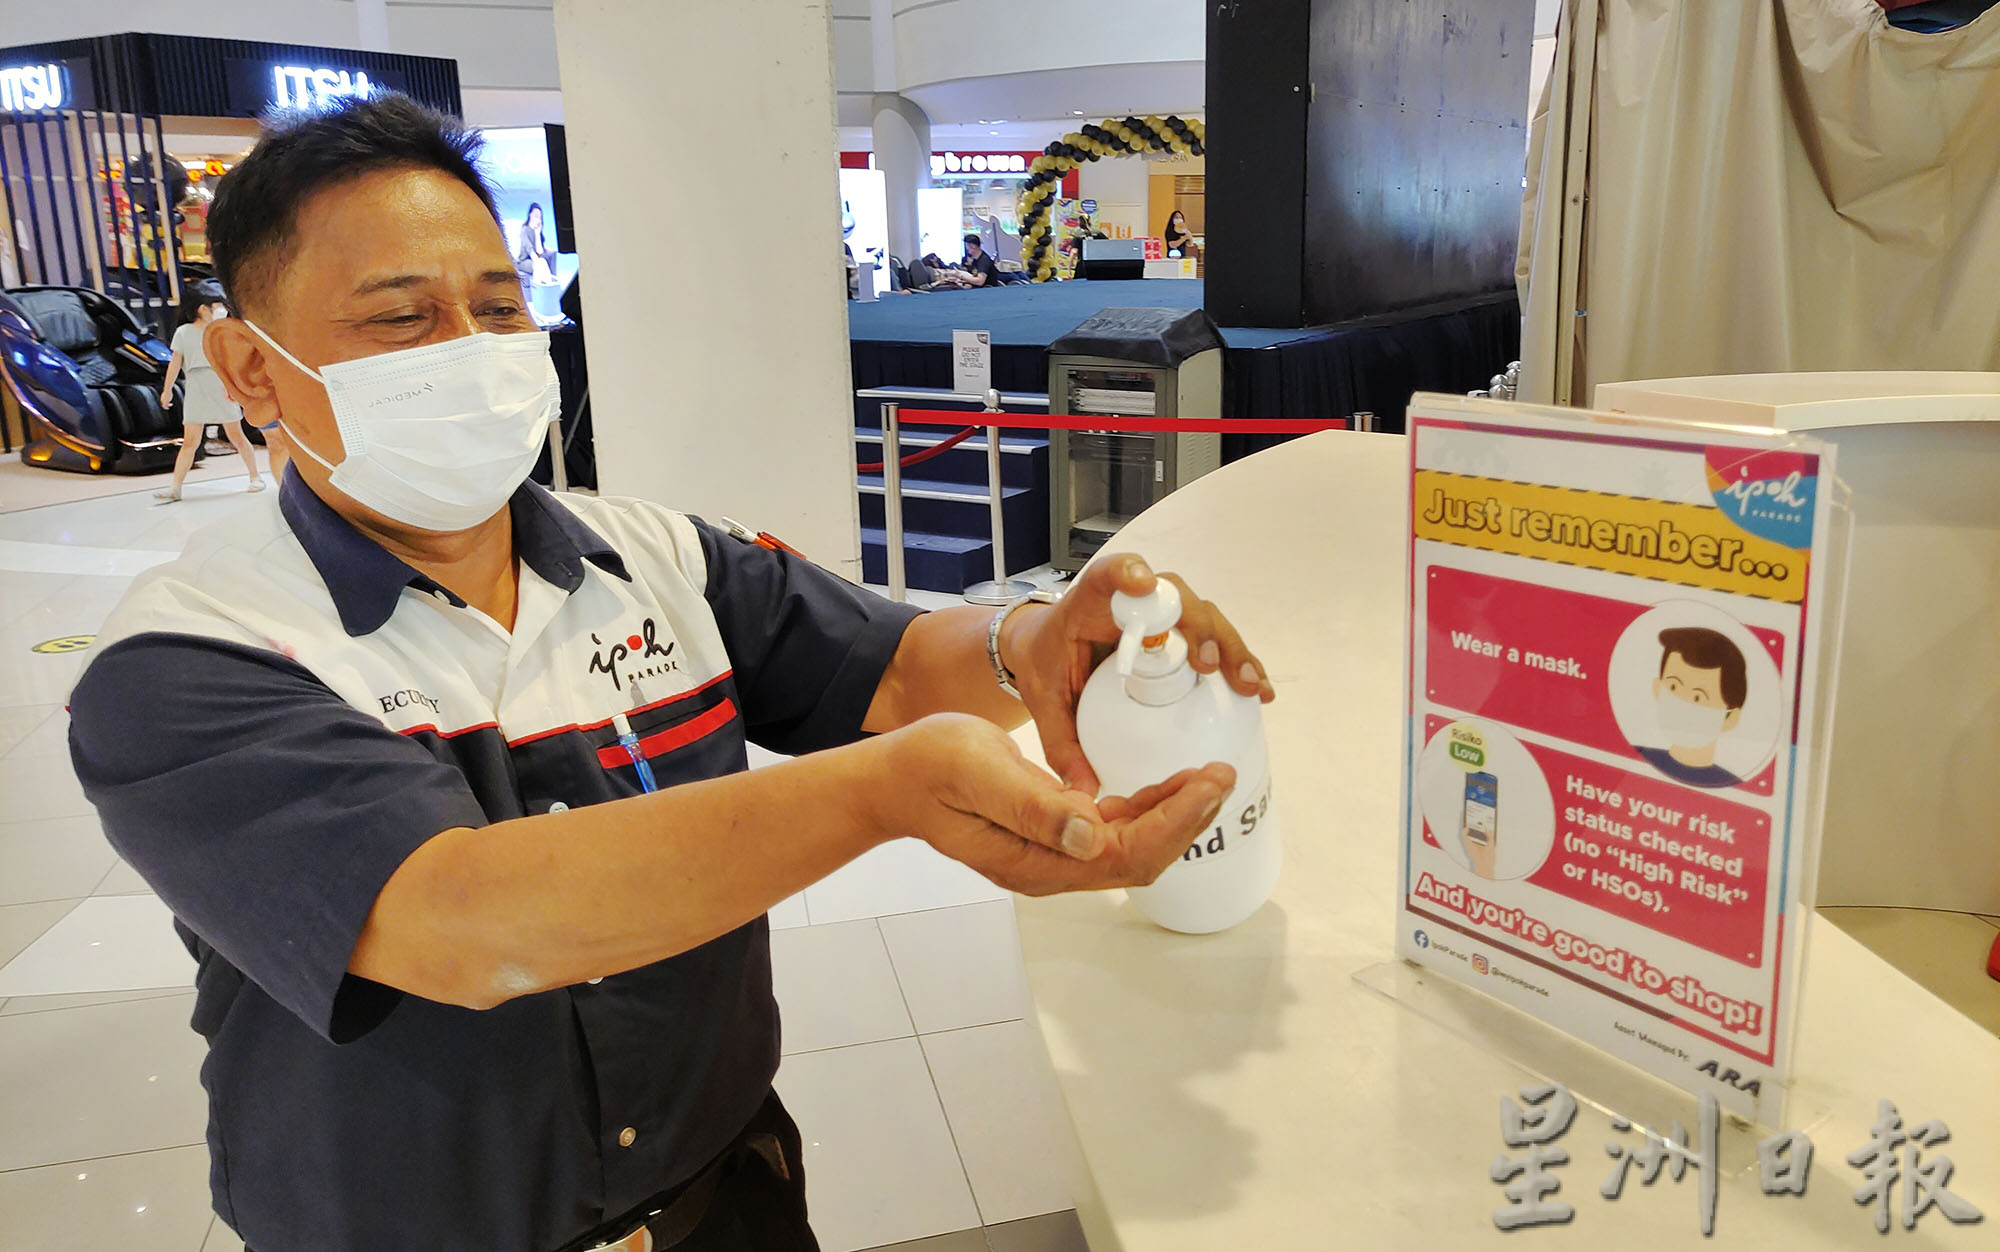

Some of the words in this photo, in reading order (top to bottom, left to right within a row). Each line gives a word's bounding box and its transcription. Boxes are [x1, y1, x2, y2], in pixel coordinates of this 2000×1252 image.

[1423, 489, 1501, 534] Just
[1509, 506, 1789, 582] remember...
[1751, 509, 1802, 523] PARADE
[628, 660, 678, 684] PARADE
[1451, 631, 1503, 660] Wear
[1507, 646, 1519, 663] a
[1525, 649, 1587, 679] mask.
[1451, 728, 1483, 746] Risiko
[1454, 744, 1480, 763] Low
[1566, 775, 1623, 809] Have
[1627, 798, 1684, 829] your
[1688, 813, 1736, 844] risk
[1563, 832, 1601, 860] (no
[1565, 806, 1634, 841] status
[1638, 825, 1744, 879] checked
[1563, 862, 1587, 881] or
[1592, 870, 1670, 914] HSOs).
[1416, 874, 1465, 908] And
[1554, 930, 1626, 974] good
[1631, 960, 1663, 995] to
[1669, 978, 1761, 1031] shop!
[1696, 1059, 1761, 1098] ARA
